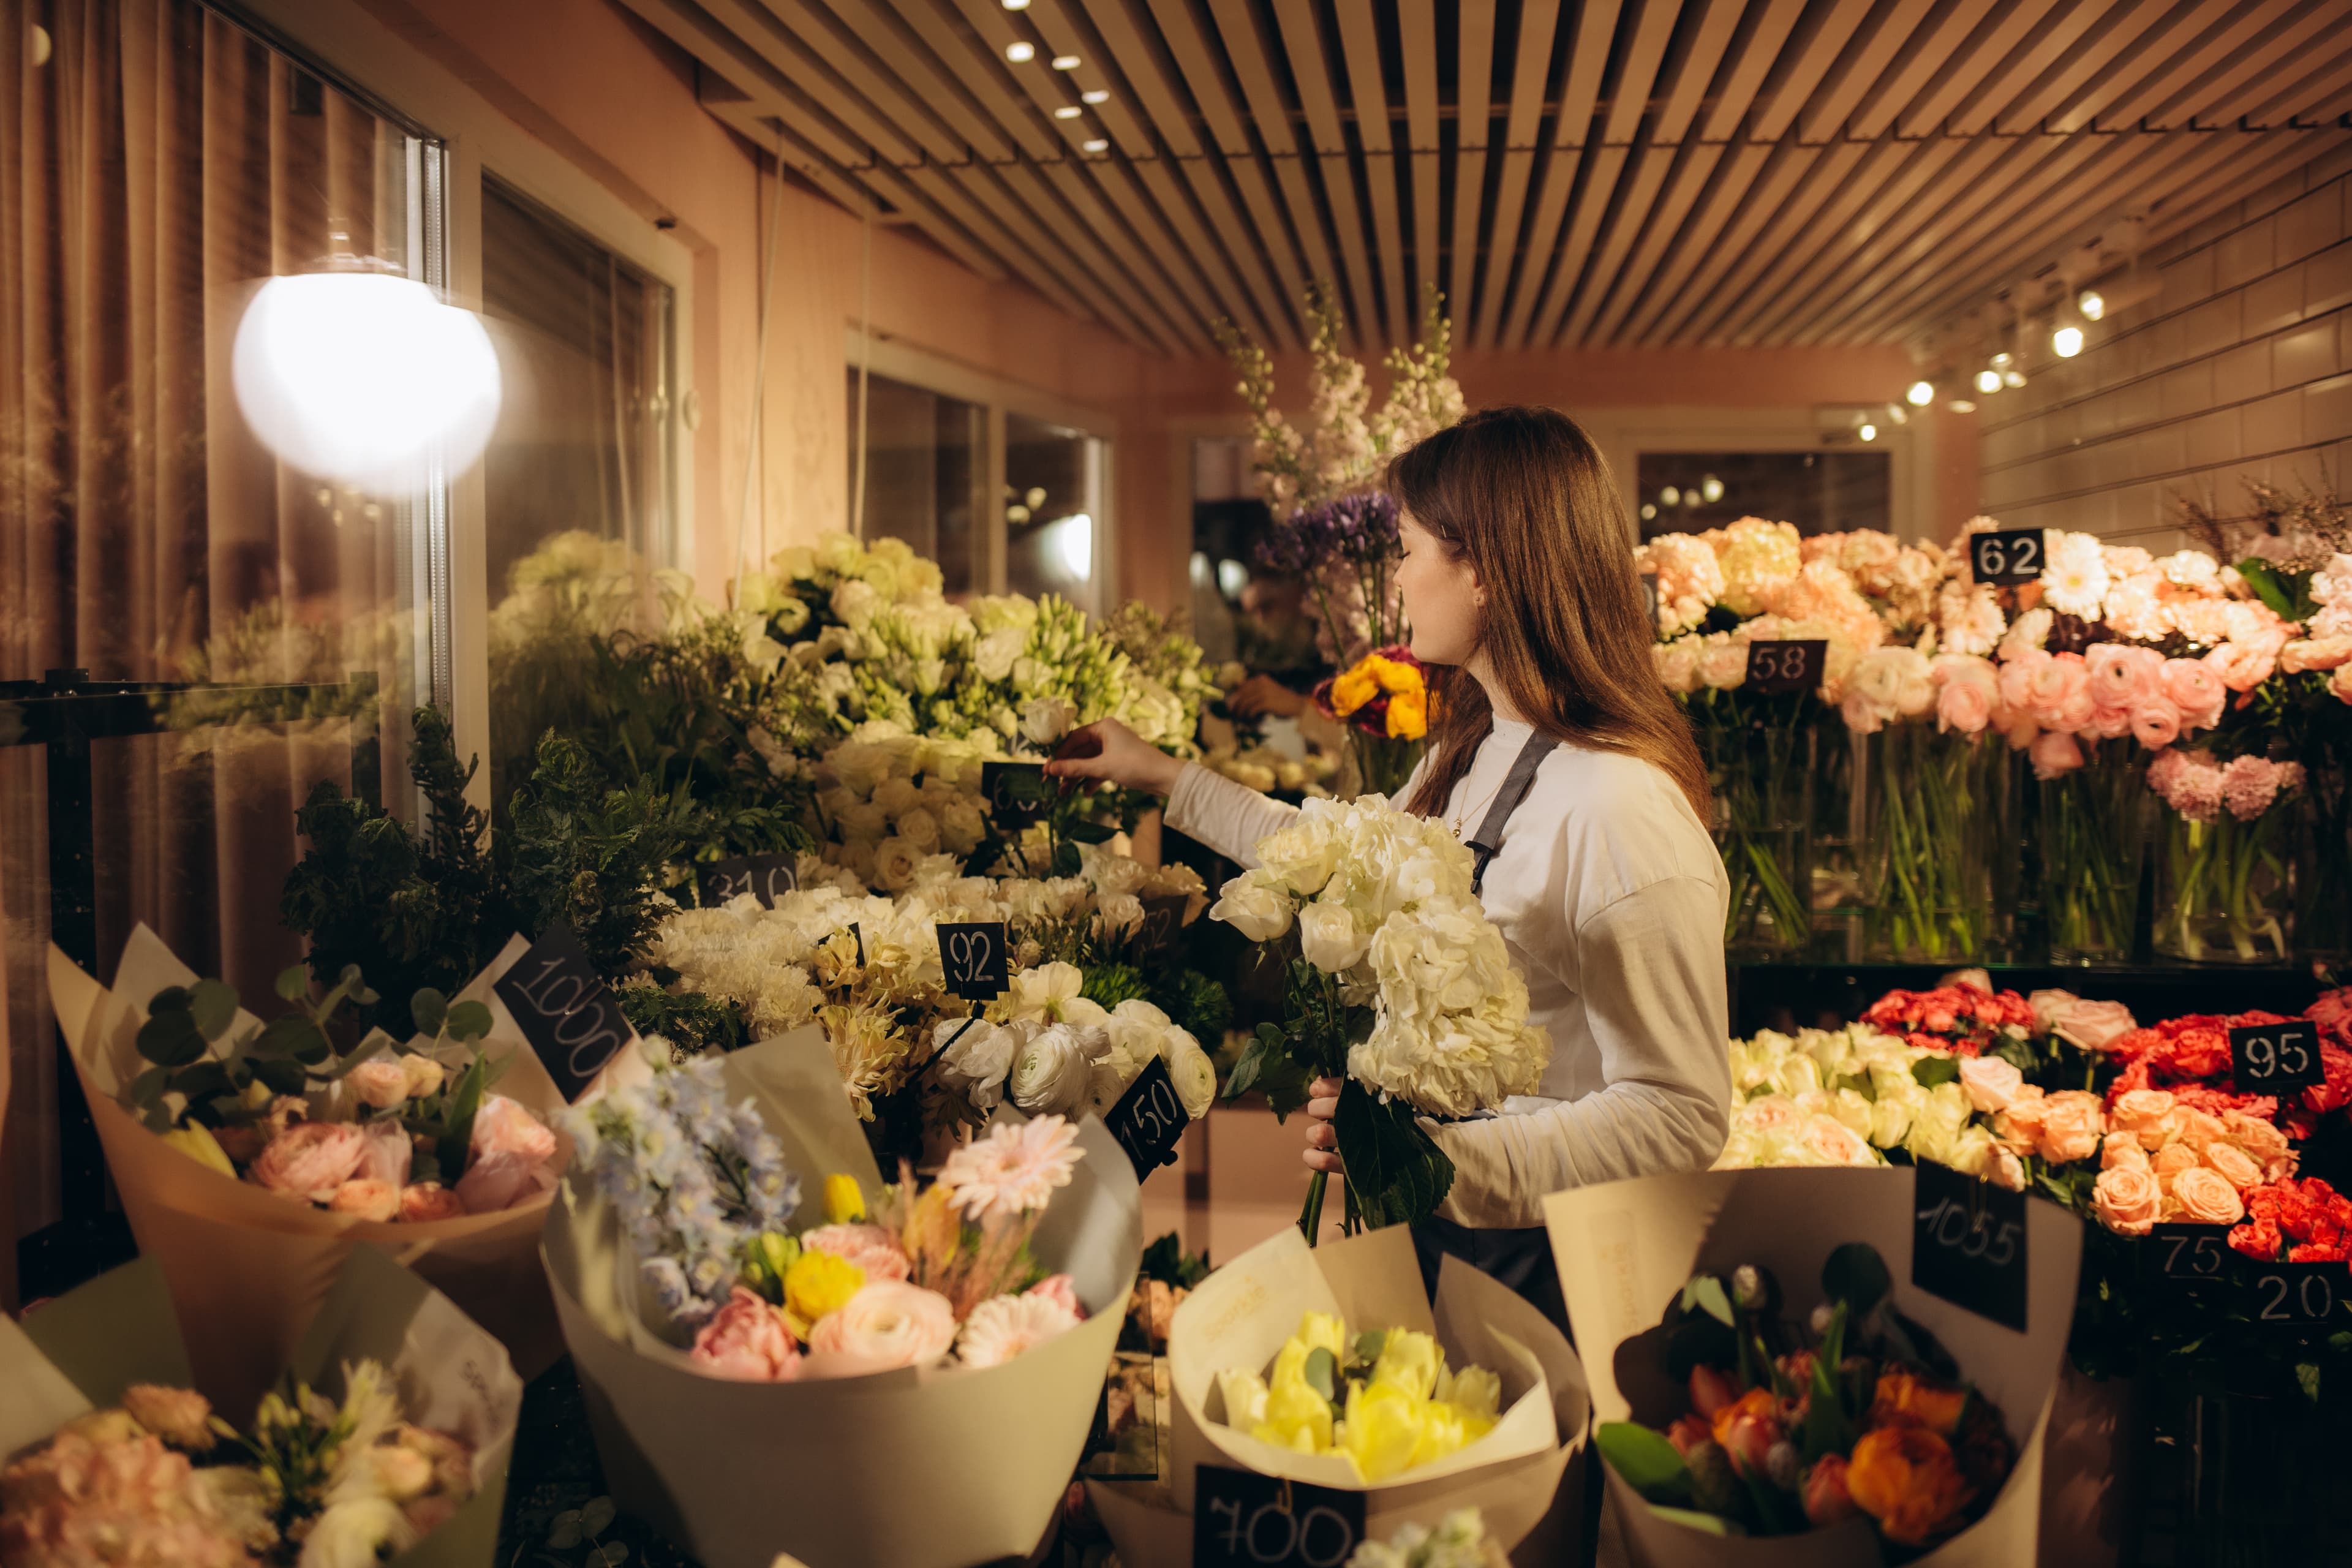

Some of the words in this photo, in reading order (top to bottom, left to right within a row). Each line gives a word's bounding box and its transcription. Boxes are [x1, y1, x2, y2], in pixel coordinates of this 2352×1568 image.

[1980, 537, 2038, 575] 62
[1752, 646, 1806, 680] 58
[1141, 908, 1171, 952] 52
[949, 931, 995, 982] 92
[511, 957, 620, 1078] 1000
[2245, 1033, 2309, 1078] 95
[1120, 1079, 1177, 1161] 150
[1918, 1196, 2024, 1265] 1055
[2161, 1235, 2221, 1273] 75
[2258, 1275, 2332, 1320] 20
[1210, 1496, 1353, 1568] 700
